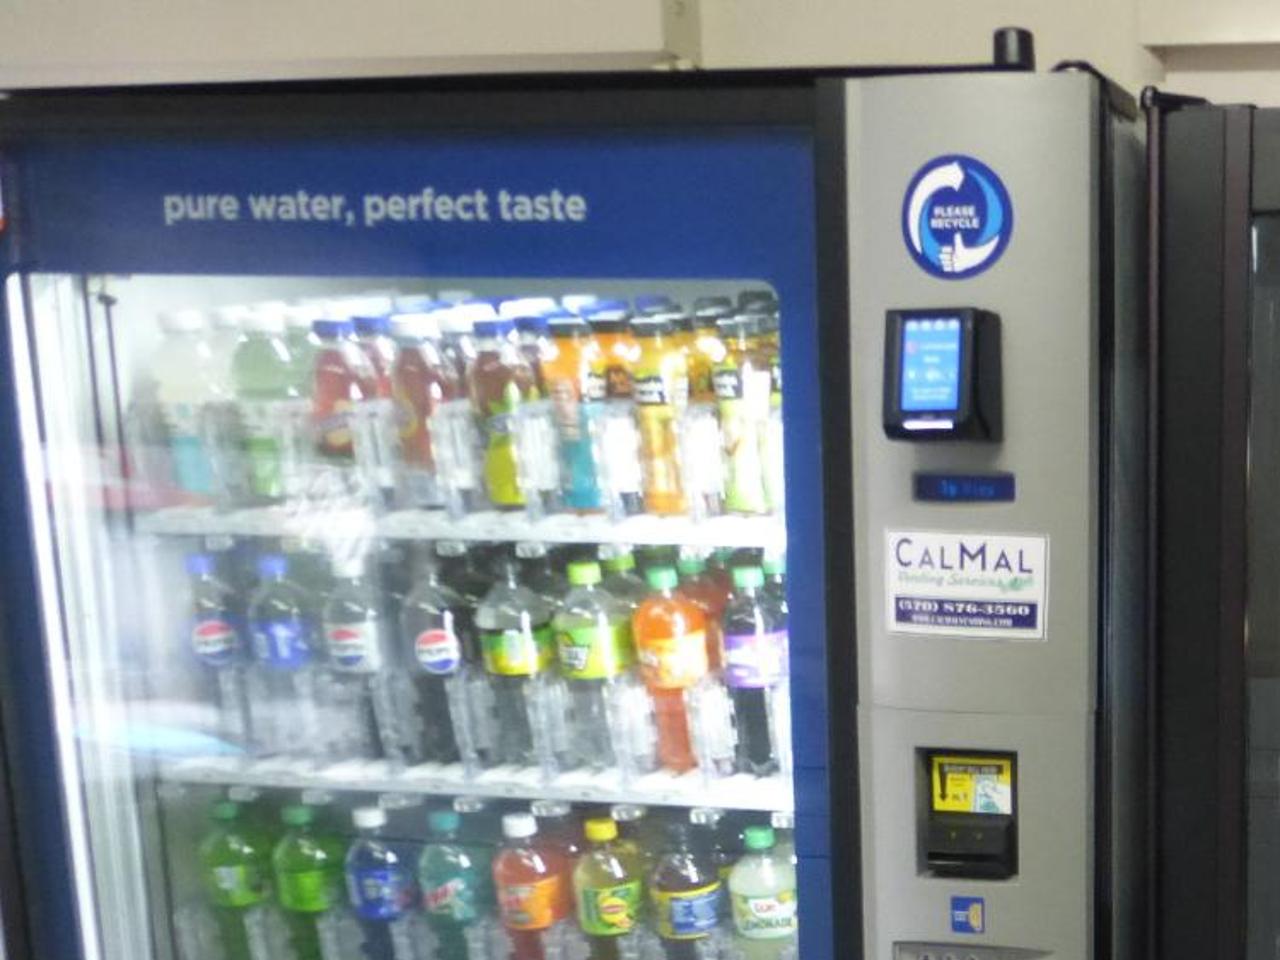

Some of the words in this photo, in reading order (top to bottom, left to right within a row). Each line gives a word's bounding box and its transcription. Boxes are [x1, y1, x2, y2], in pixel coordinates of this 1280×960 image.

[164, 192, 238, 226] pure
[250, 190, 356, 227] water,
[364, 188, 490, 227] perfect
[498, 191, 587, 222] taste
[934, 205, 976, 217] PLEASE
[930, 218, 980, 229] RECYCLE
[898, 600, 939, 613] (570)
